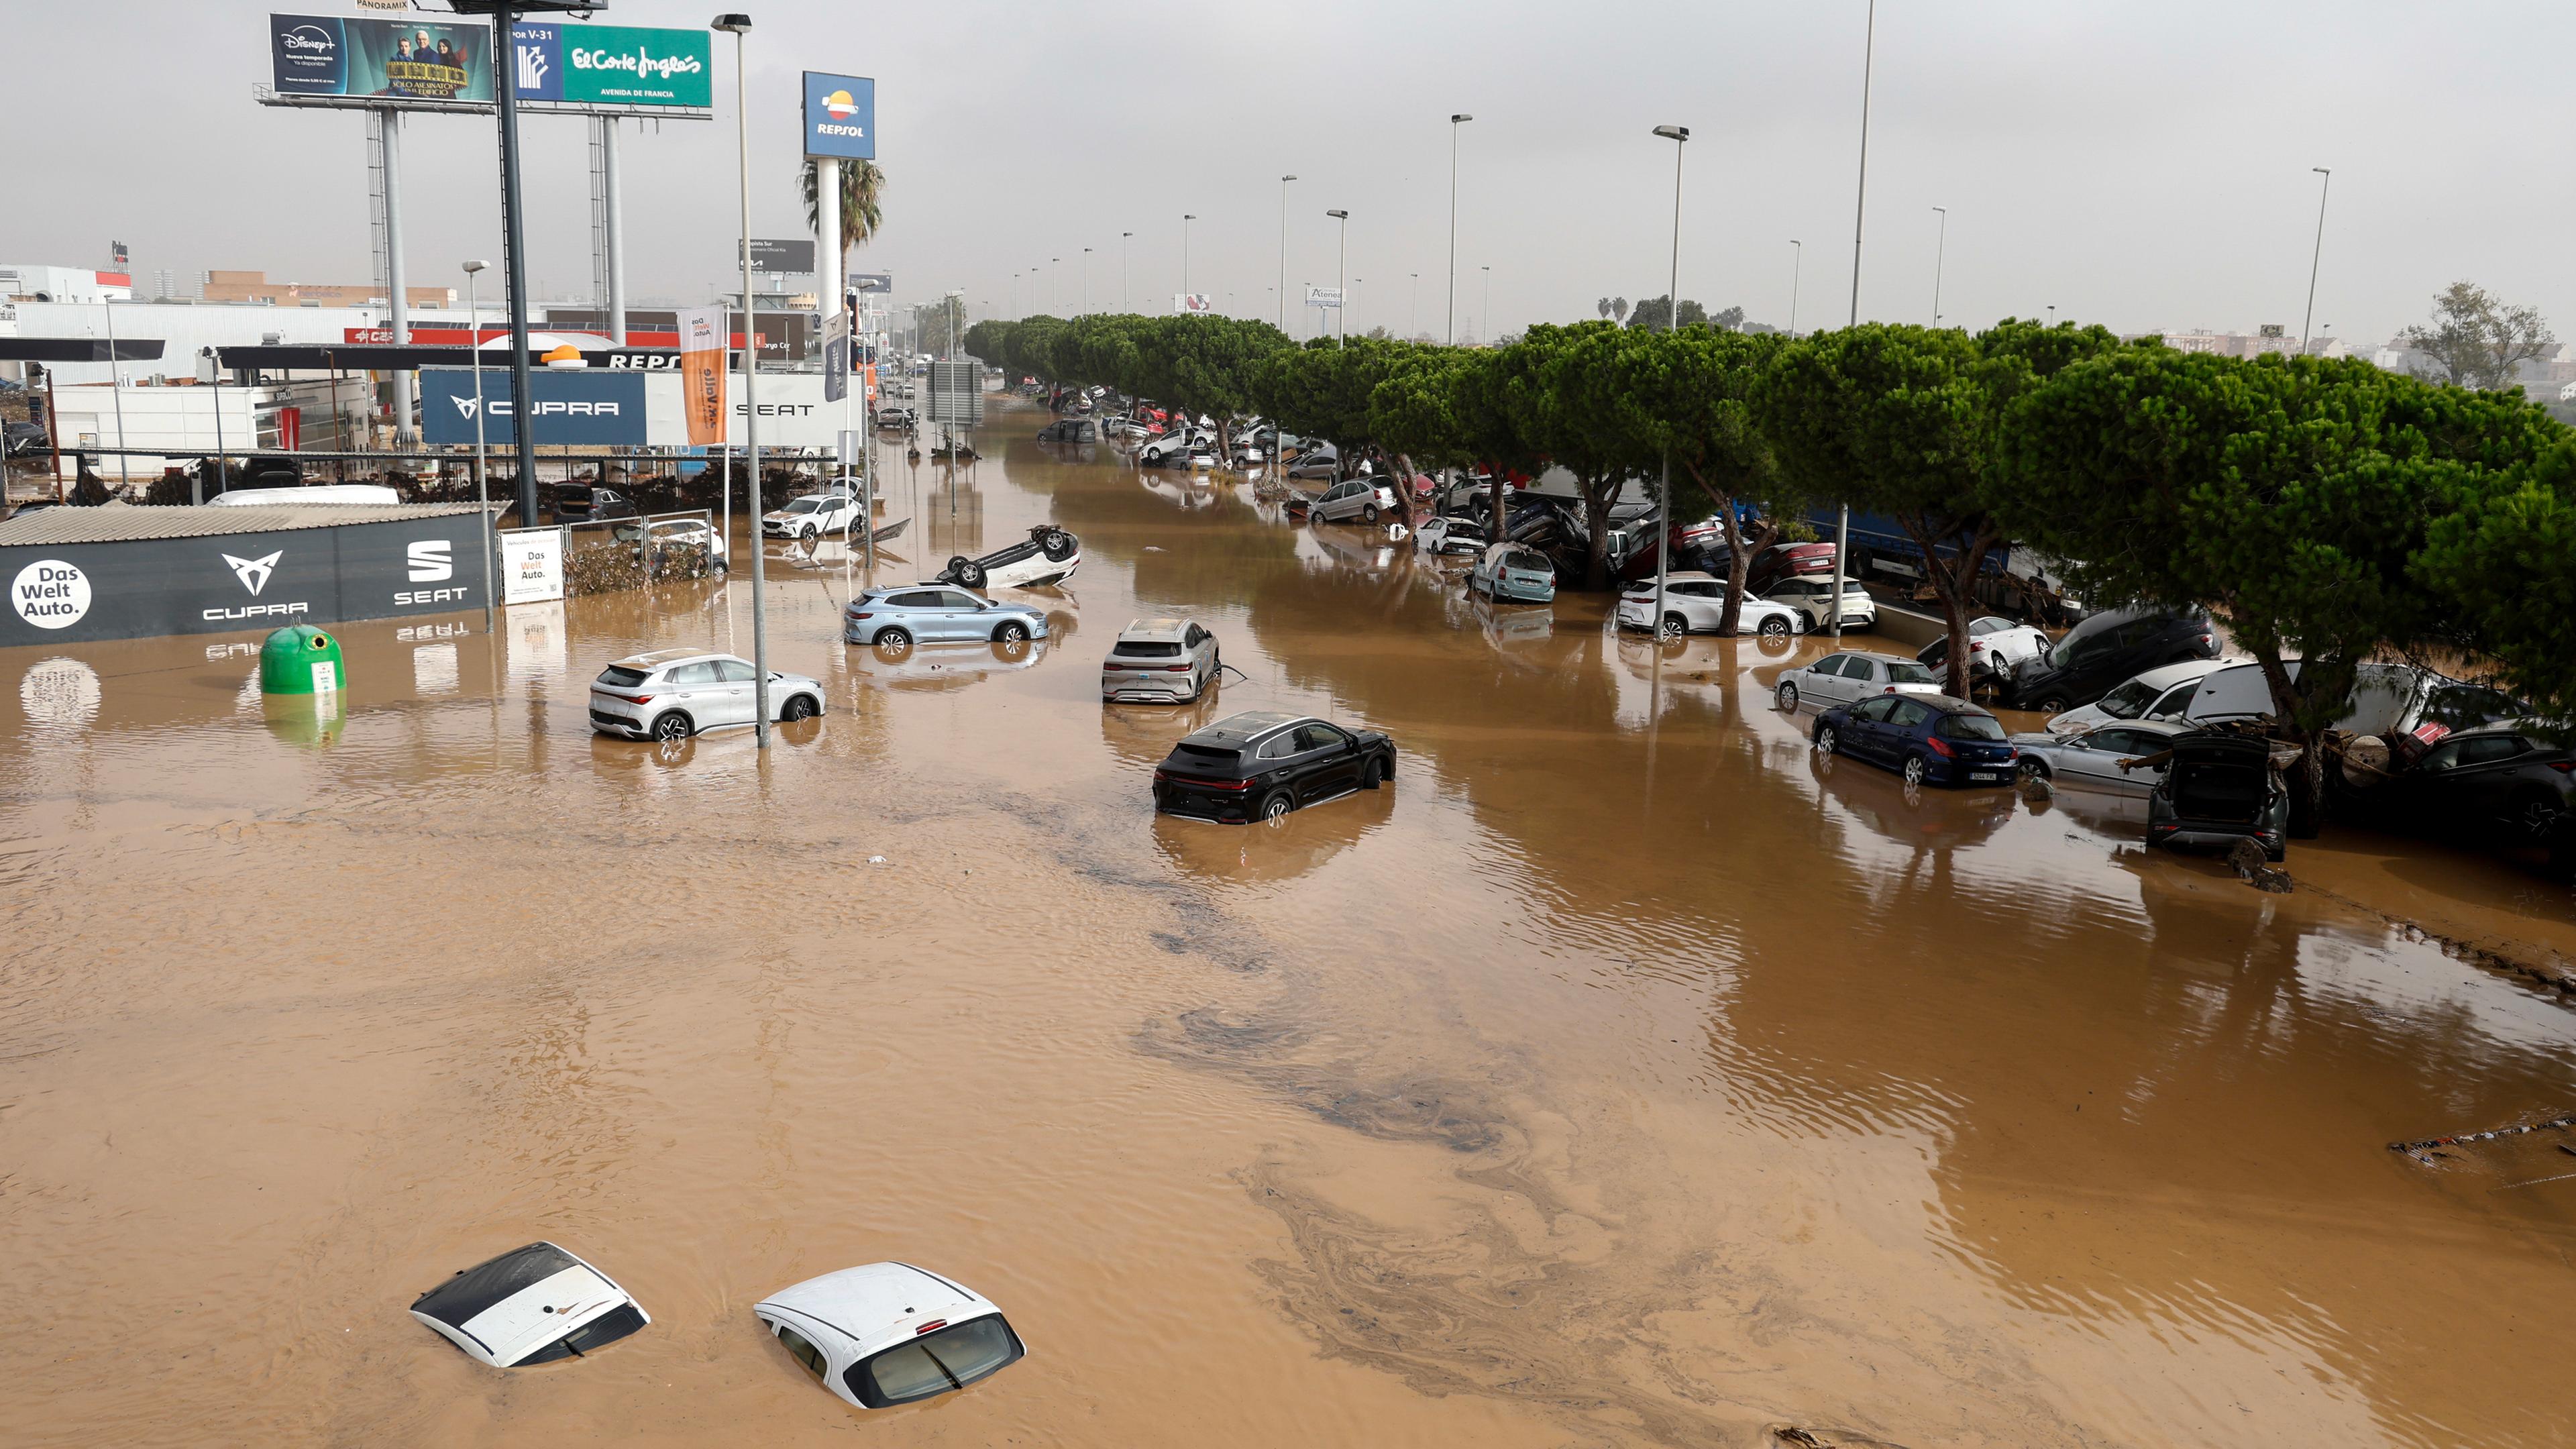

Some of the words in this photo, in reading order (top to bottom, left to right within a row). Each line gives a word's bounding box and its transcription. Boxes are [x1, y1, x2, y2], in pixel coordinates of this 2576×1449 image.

[357, 0, 407, 9] PANORAMIX
[528, 30, 552, 40] V-31
[572, 48, 591, 68] El
[592, 50, 637, 70] Corte
[638, 46, 701, 79] Inglés
[817, 123, 863, 138] REPSOL
[609, 355, 681, 368] REPS
[528, 551, 545, 560] Das
[521, 561, 541, 570] Welt
[39, 567, 78, 583] Das
[522, 571, 545, 580] Auto.
[21, 584, 70, 599] Welt
[394, 588, 468, 605] SEAT
[23, 600, 80, 617] Auto.
[203, 602, 308, 621] CUPRA
